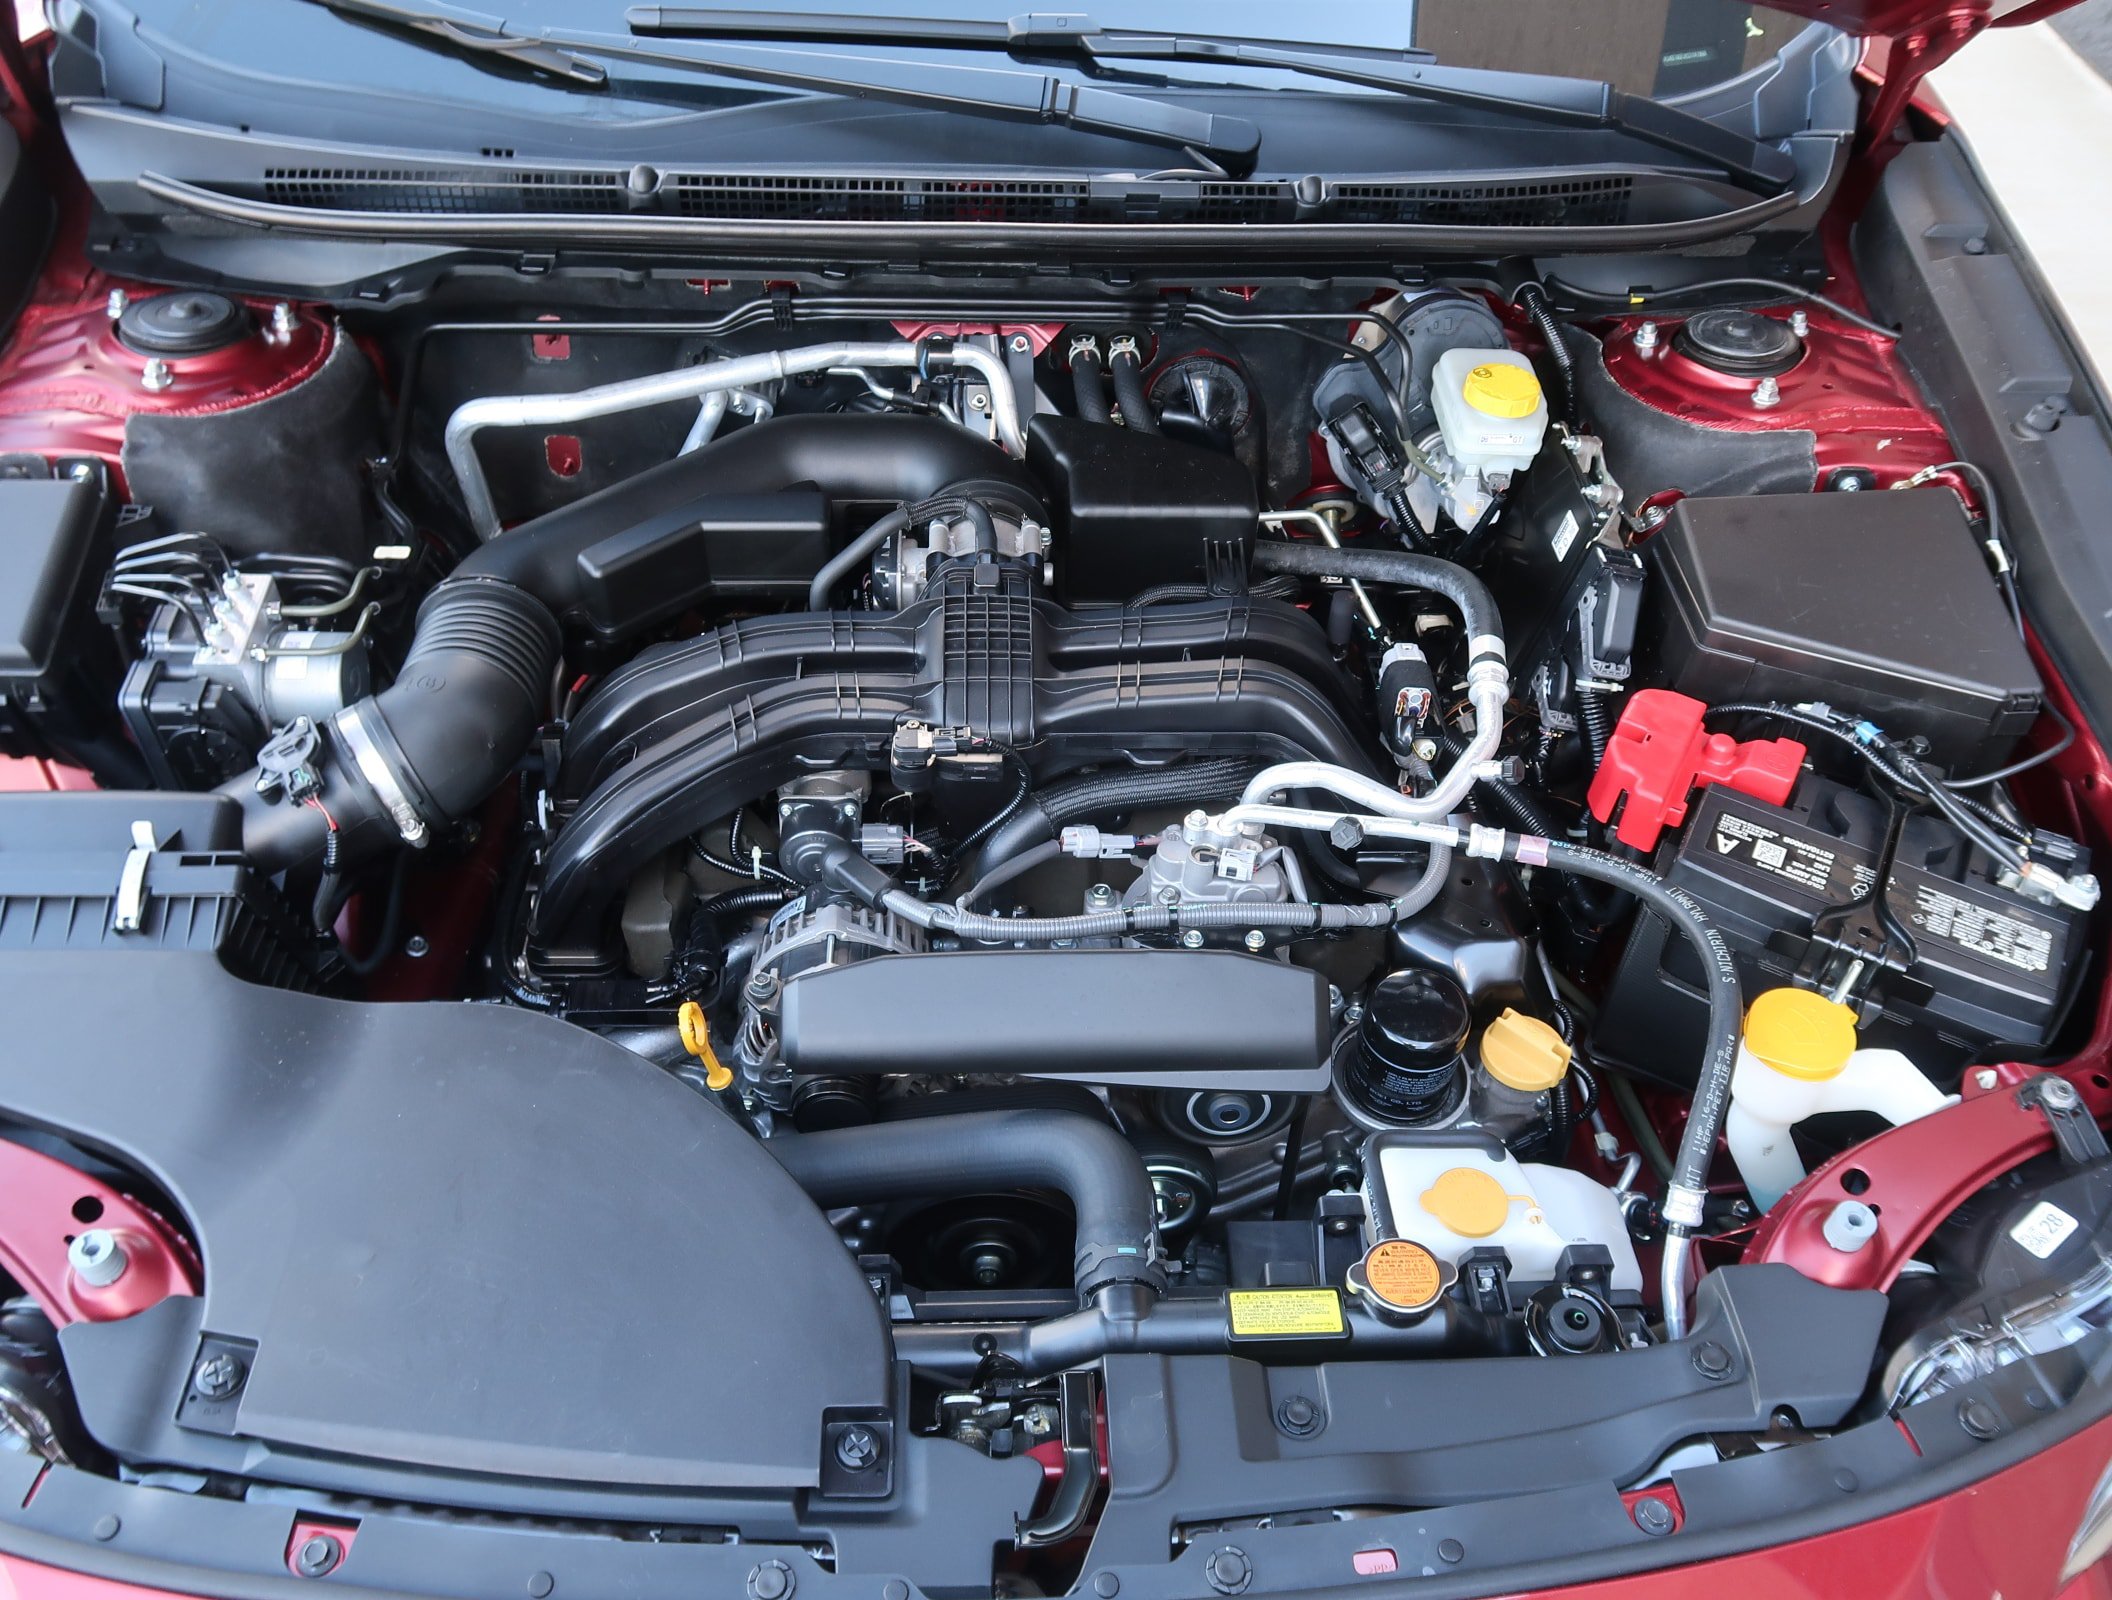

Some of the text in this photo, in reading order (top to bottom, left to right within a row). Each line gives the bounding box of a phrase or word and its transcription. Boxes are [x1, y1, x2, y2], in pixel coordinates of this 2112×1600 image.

[1716, 832, 1741, 855] A
[1634, 871, 1658, 886] 11HP
[1785, 865, 1811, 879] AMPS
[1692, 1049, 1725, 1151] 11HP 16-D-H-DE-S
[2039, 1213, 2065, 1235] 28
